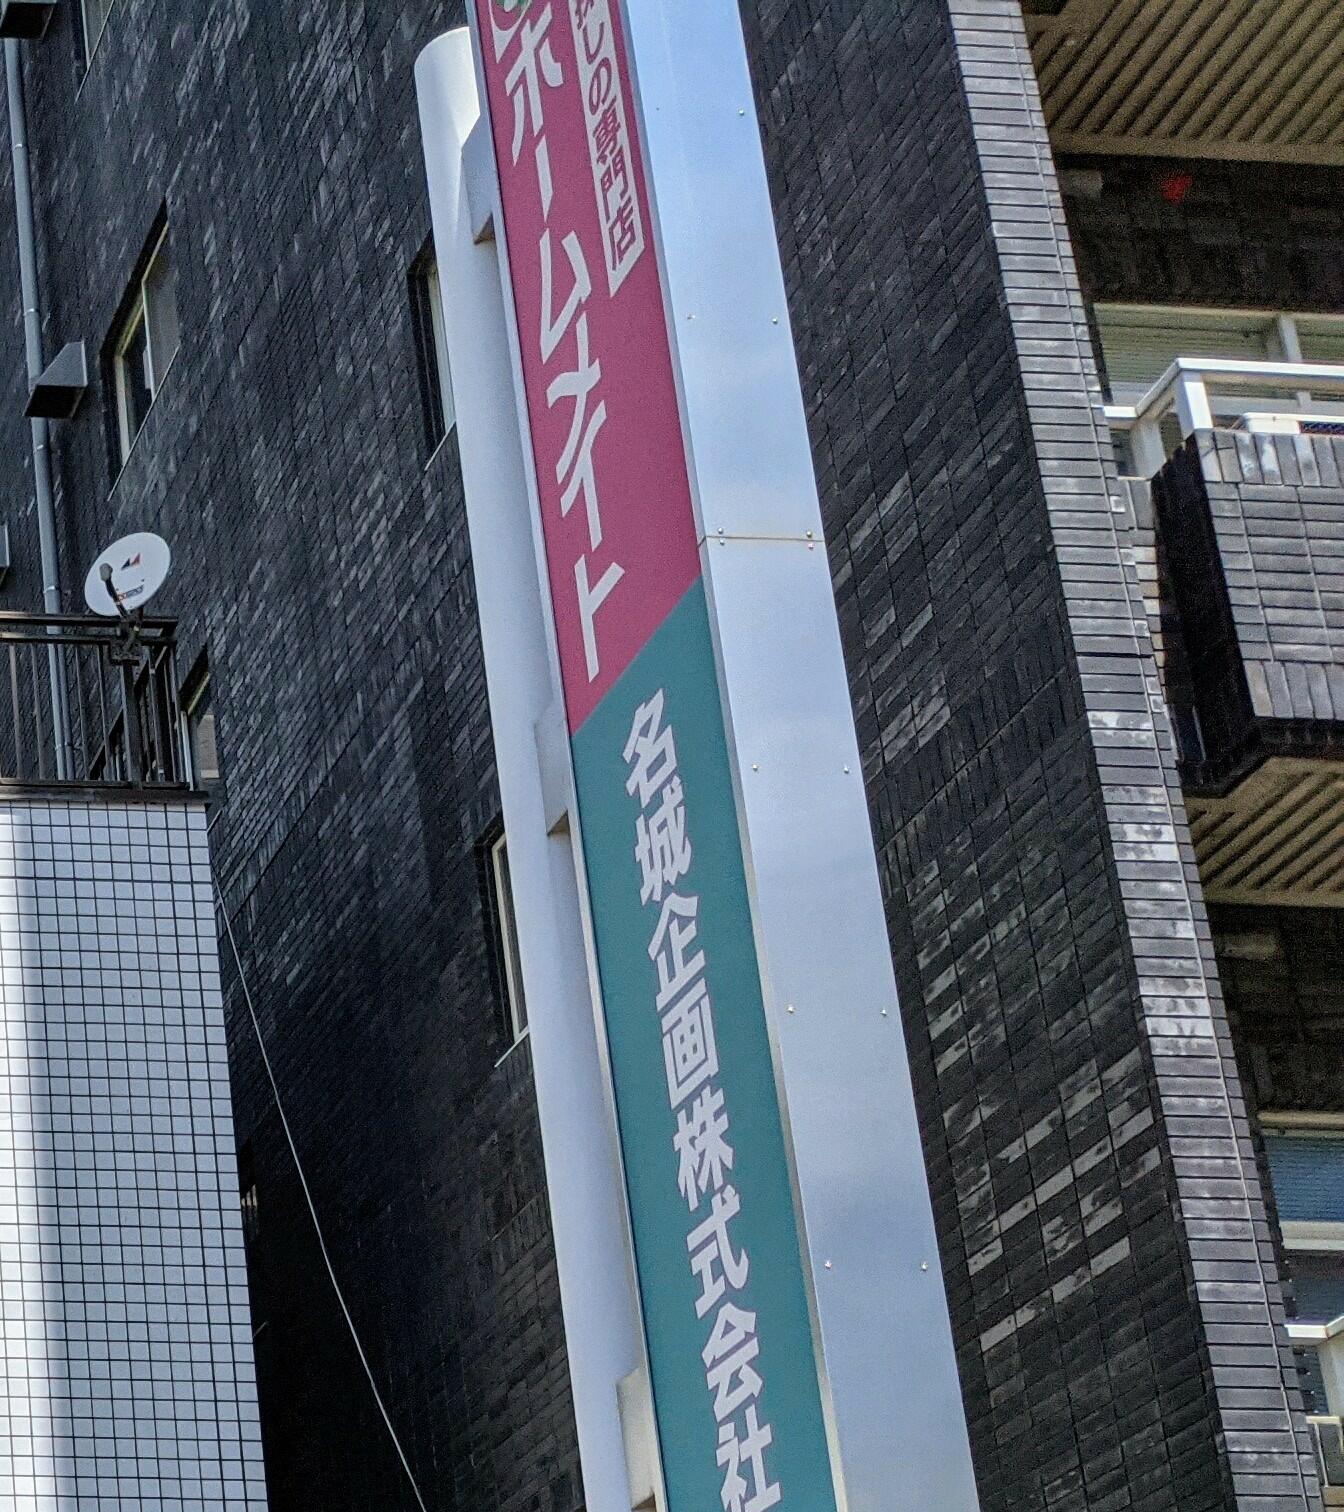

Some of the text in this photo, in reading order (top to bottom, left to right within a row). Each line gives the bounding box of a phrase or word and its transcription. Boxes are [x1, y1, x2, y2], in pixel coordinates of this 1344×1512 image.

[504, 1, 625, 683] ホームメイト
